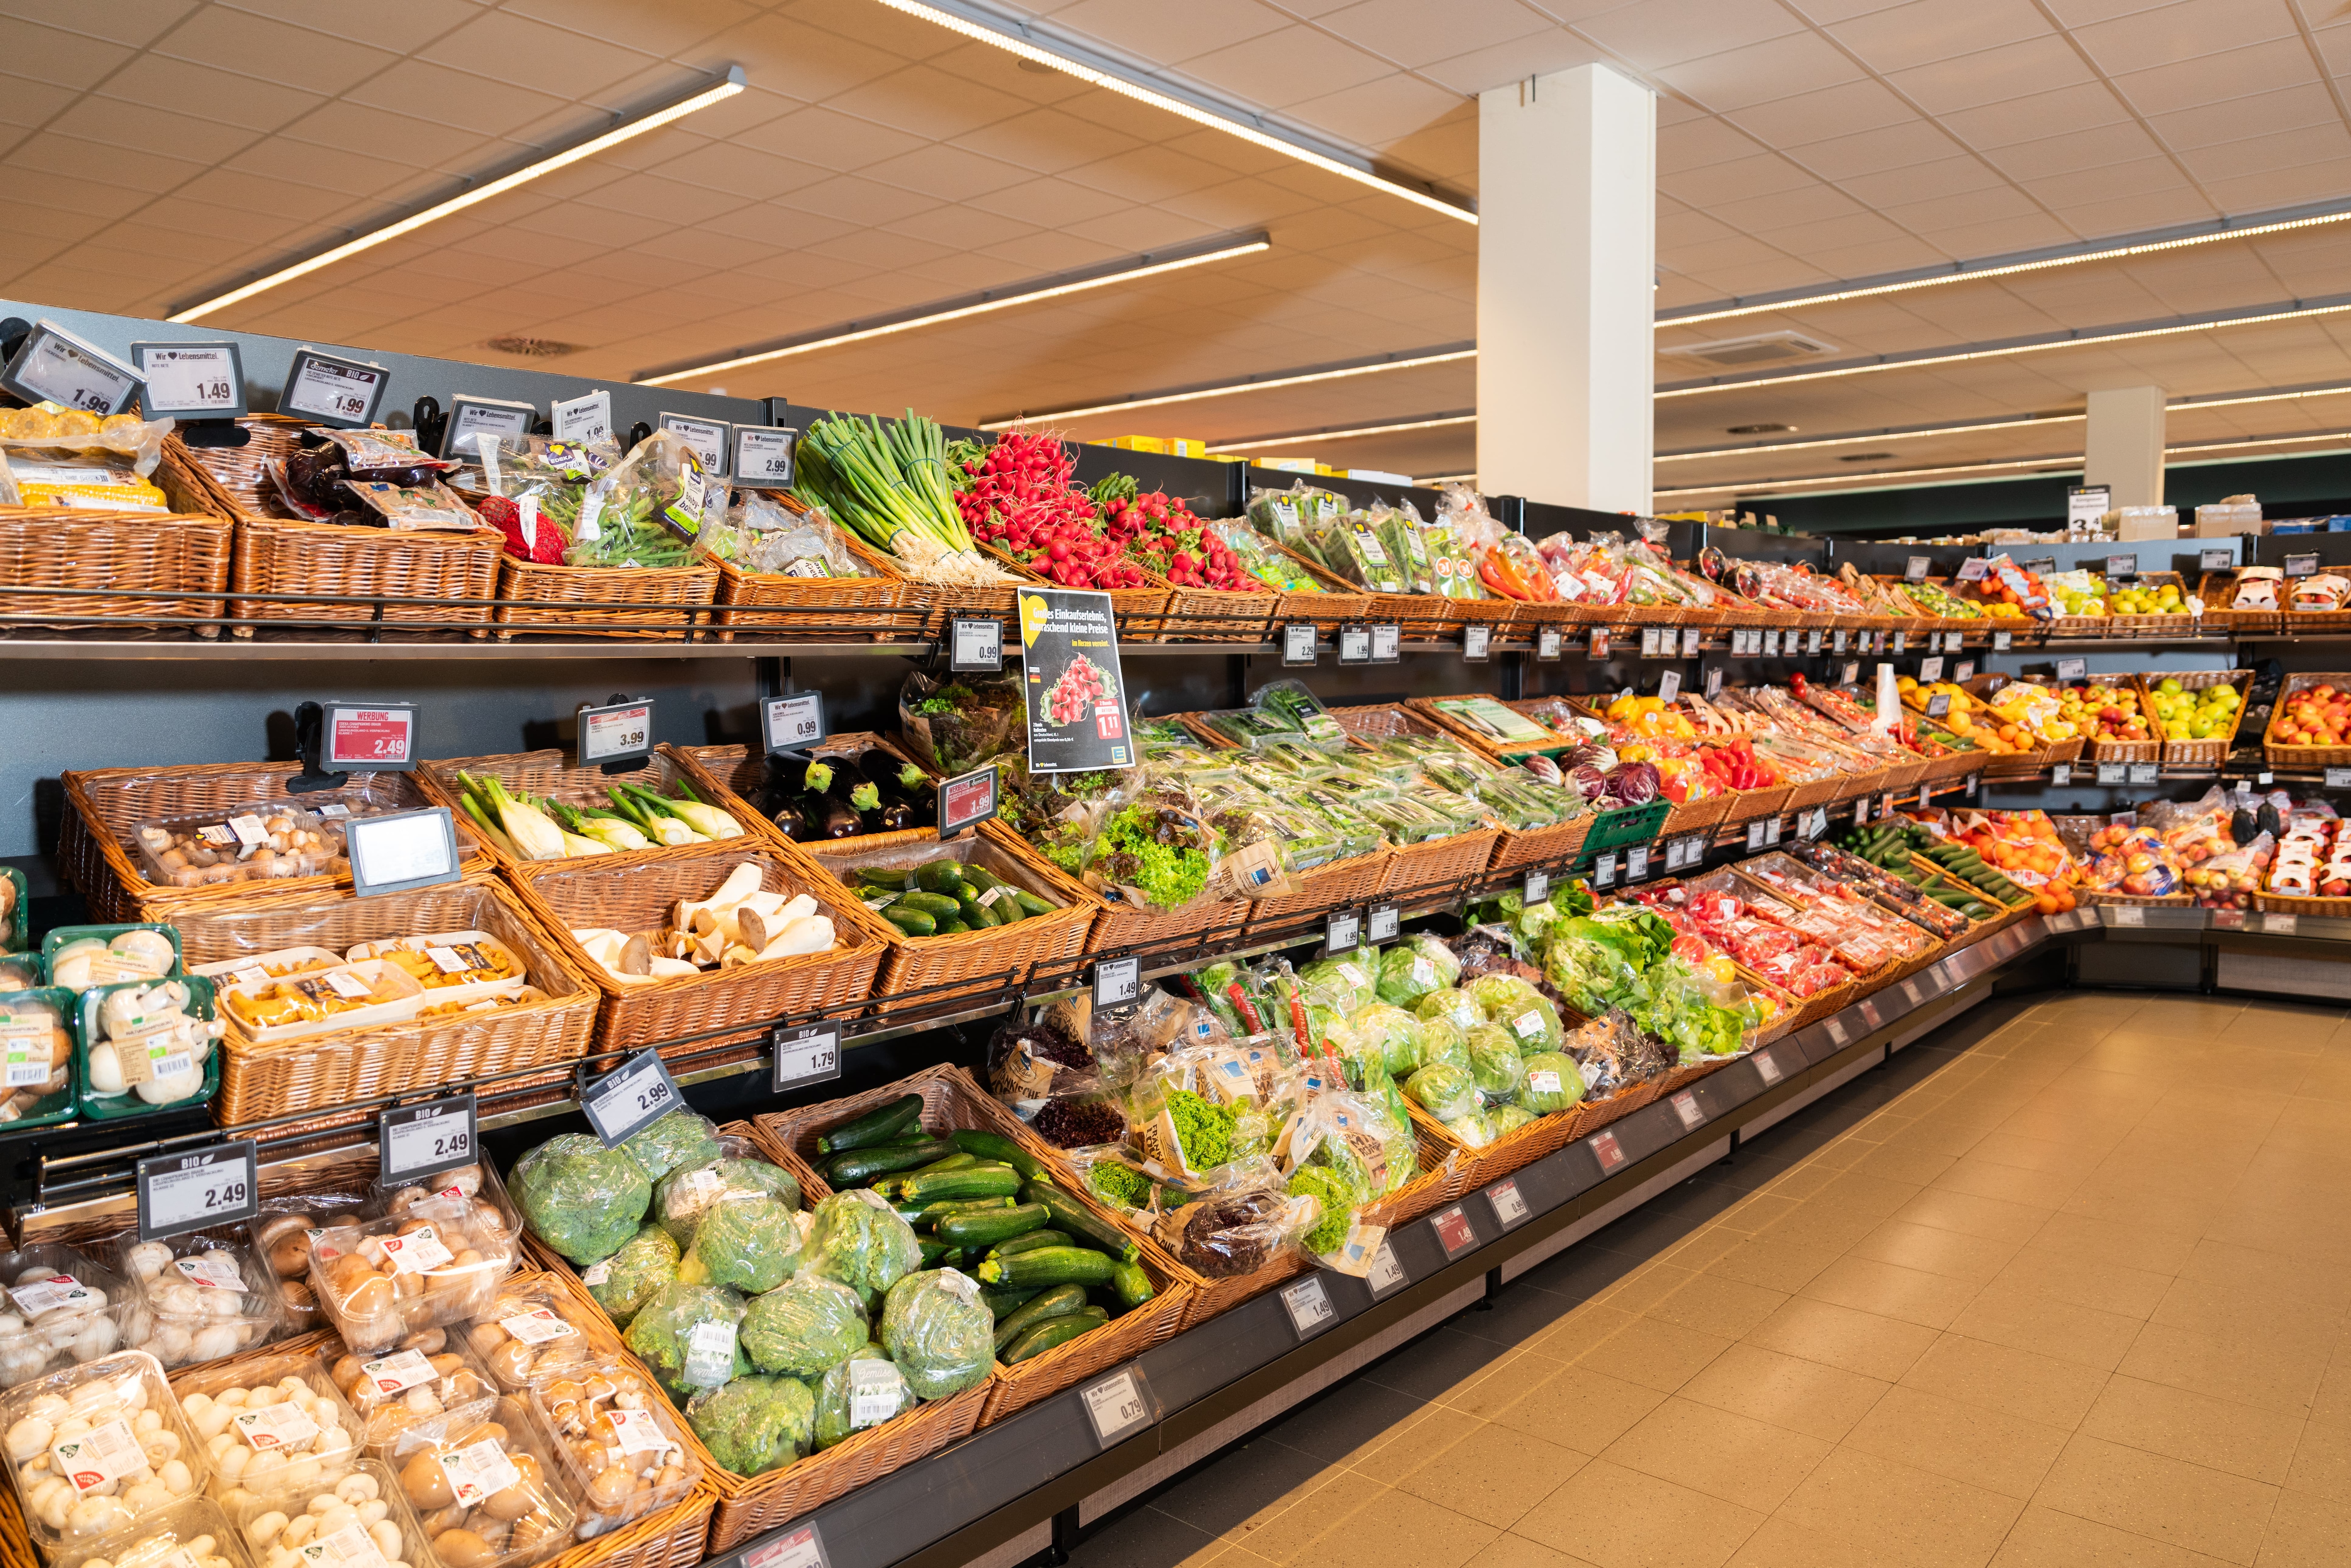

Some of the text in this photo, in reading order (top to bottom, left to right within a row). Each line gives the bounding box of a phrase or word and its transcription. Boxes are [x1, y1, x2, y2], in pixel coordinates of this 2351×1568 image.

[44, 348, 67, 362] ZUCKERMAIS
[54, 342, 120, 383] Wir Lebensmittel.
[310, 362, 359, 379] demeter BIO
[197, 383, 230, 399] 1.49
[73, 388, 111, 414] 1.99
[336, 395, 364, 413] 1.99
[579, 403, 600, 414] Lebensmittel.
[550, 456, 573, 464] EDEKA
[766, 459, 785, 472] 2.99
[686, 492, 700, 509] Bobby-
[679, 500, 699, 519] bohnen
[1033, 607, 1107, 623] Großes Einkaufserlebnis,
[1029, 621, 1108, 634] überraschend kleine Preise
[979, 646, 997, 658] 0.99
[1302, 646, 1314, 656] 2.29
[1357, 645, 1367, 654] 1.99
[1387, 645, 1397, 654] 1.99
[788, 700, 810, 708] Lebensmittel.
[357, 712, 389, 720] WERBUNG
[601, 711, 631, 723] DISCOUNT BILLIG
[797, 721, 816, 735] 0.99
[620, 731, 644, 746] 3.99
[374, 740, 405, 754] 2.49
[949, 781, 969, 794] WERBUNG
[971, 777, 988, 786] demeter
[971, 795, 989, 812] 1.99
[1538, 886, 1546, 896] 1.99
[1385, 922, 1396, 933] 1.99
[1345, 931, 1357, 943] 1.99
[1114, 961, 1133, 969] Lebensmittel.
[1120, 982, 1136, 996] 1.49
[799, 1029, 809, 1039] BIO
[812, 1051, 834, 1069] 1.79
[1221, 1065, 1234, 1078] EDEKA
[606, 1076, 622, 1090] BIO
[623, 1077, 643, 1091] VERPACKUNG
[637, 1081, 669, 1111] 2.99
[415, 1108, 431, 1120] BIO
[399, 1122, 423, 1131] CHAMPIGNONS
[427, 1119, 450, 1128] VERPACKUNG
[434, 1133, 468, 1156] 2.49
[181, 1156, 200, 1169] BIO
[153, 1168, 224, 1186] URSPRUNGSLAND VERPACKUNG
[159, 1170, 190, 1181] CHAMPIGNONS
[205, 1182, 246, 1208] 2.49
[1512, 1199, 1524, 1213] 0.99
[1441, 1211, 1455, 1222] WERBUNG
[1458, 1227, 1472, 1241] 1.49
[1385, 1264, 1401, 1279] 1.49
[1297, 1281, 1316, 1293] Lebensmittel.
[1313, 1300, 1330, 1316] 1.49
[692, 1367, 726, 1380] Gemüse
[857, 1368, 892, 1382] Gemüse
[1103, 1376, 1126, 1392] Lebensmittel.
[1120, 1399, 1142, 1419] 0.79
[119, 1421, 129, 1435] EDEKA
[77, 1473, 101, 1482] GÜNSTIG
[762, 1536, 795, 1561] DISCOUNT BILLIG
